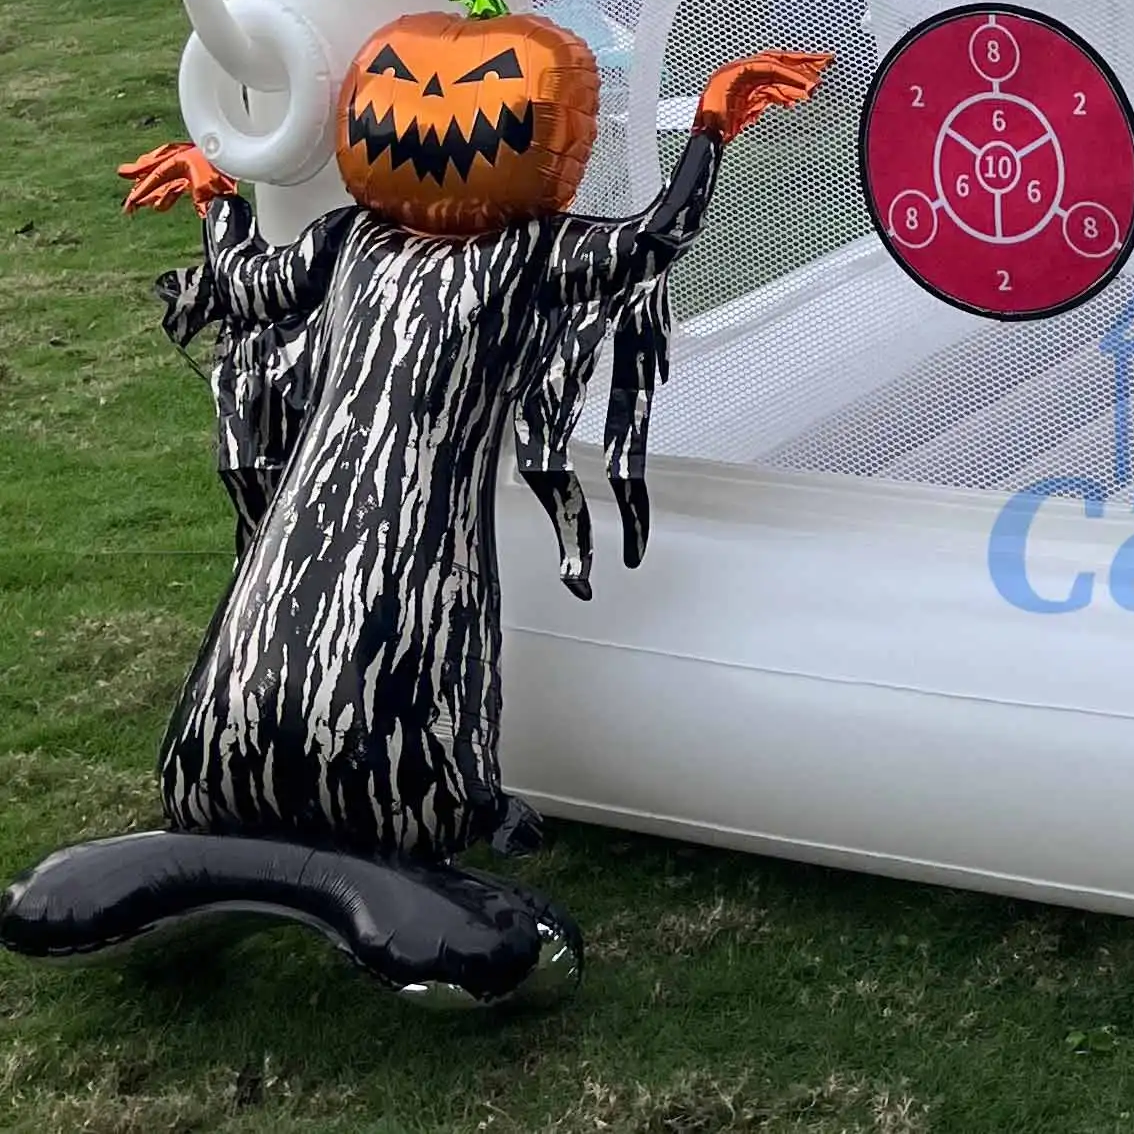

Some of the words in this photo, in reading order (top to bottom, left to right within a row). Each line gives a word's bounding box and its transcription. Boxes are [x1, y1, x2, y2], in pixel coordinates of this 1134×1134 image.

[986, 40, 1000, 62] 8
[911, 86, 925, 107] 2
[1073, 93, 1087, 115] 2
[992, 111, 1006, 131] 6
[985, 156, 1011, 178] 10
[956, 175, 969, 197] 6
[1027, 181, 1041, 202] 6
[906, 208, 919, 230] 8
[1083, 217, 1098, 239] 8
[997, 270, 1012, 291] 2
